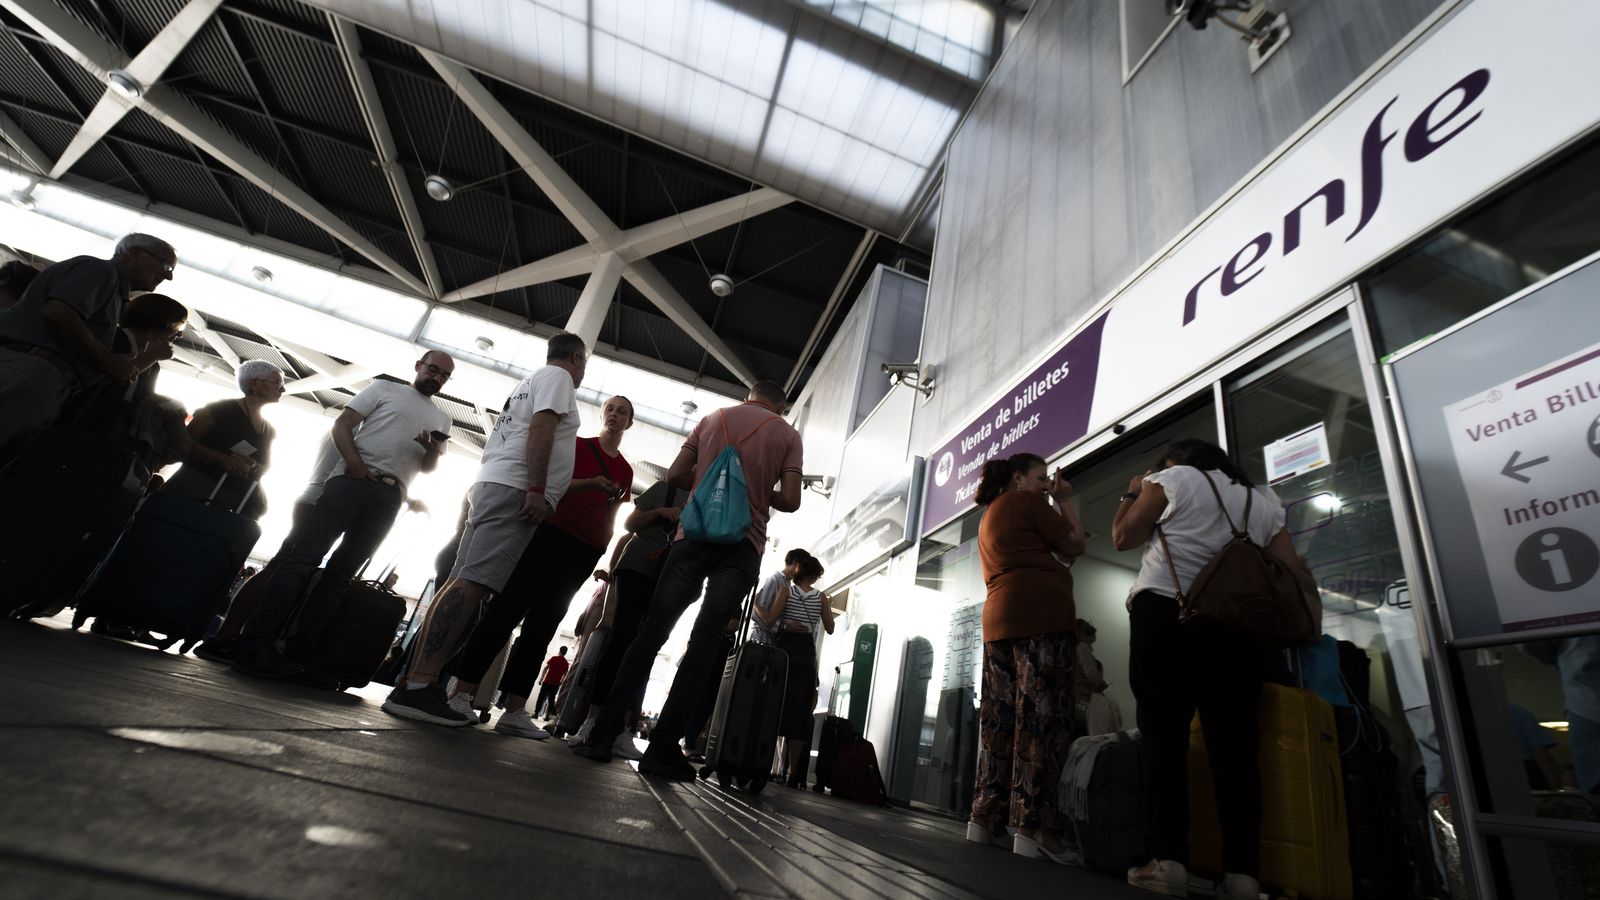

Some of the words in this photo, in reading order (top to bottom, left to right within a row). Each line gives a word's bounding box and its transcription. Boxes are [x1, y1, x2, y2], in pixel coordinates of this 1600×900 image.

[1182, 67, 1491, 327] renfe
[958, 452, 986, 480] Venda
[986, 441, 1000, 460] de
[1001, 412, 1040, 450] bitllets
[961, 422, 992, 455] Venta
[995, 408, 1011, 429] de
[1014, 361, 1069, 416] billetes
[1466, 408, 1538, 442] Venta
[1546, 381, 1600, 414] Bill
